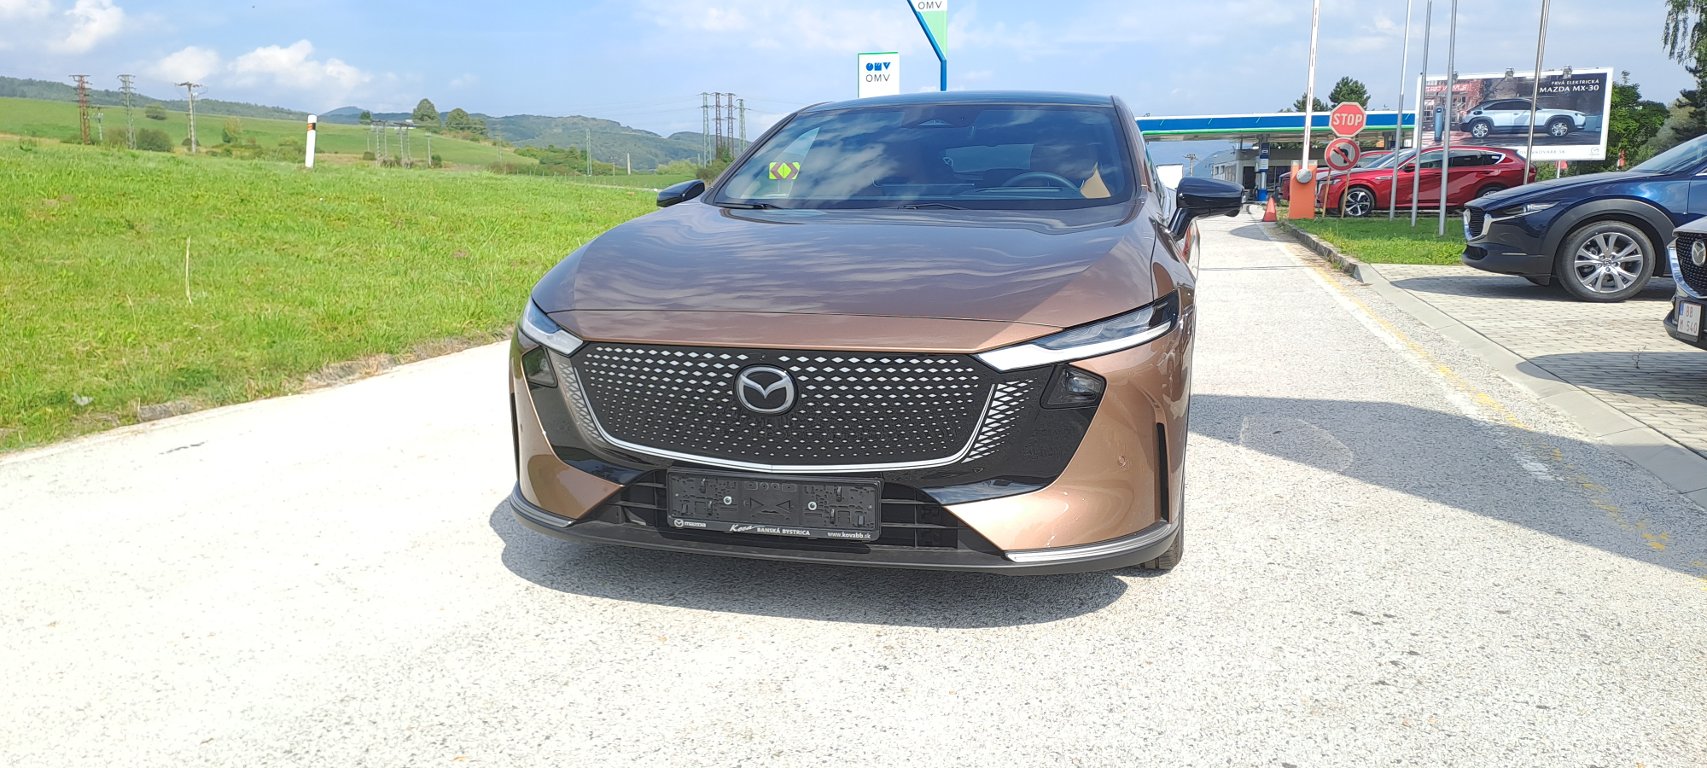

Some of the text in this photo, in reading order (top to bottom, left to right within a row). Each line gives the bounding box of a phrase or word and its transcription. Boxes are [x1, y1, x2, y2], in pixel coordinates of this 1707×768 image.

[917, 1, 942, 10] OMV
[865, 73, 890, 82] OMV
[1572, 84, 1600, 92] MX-30
[1333, 113, 1363, 126] STOP
[782, 528, 811, 536] BYSTRICA
